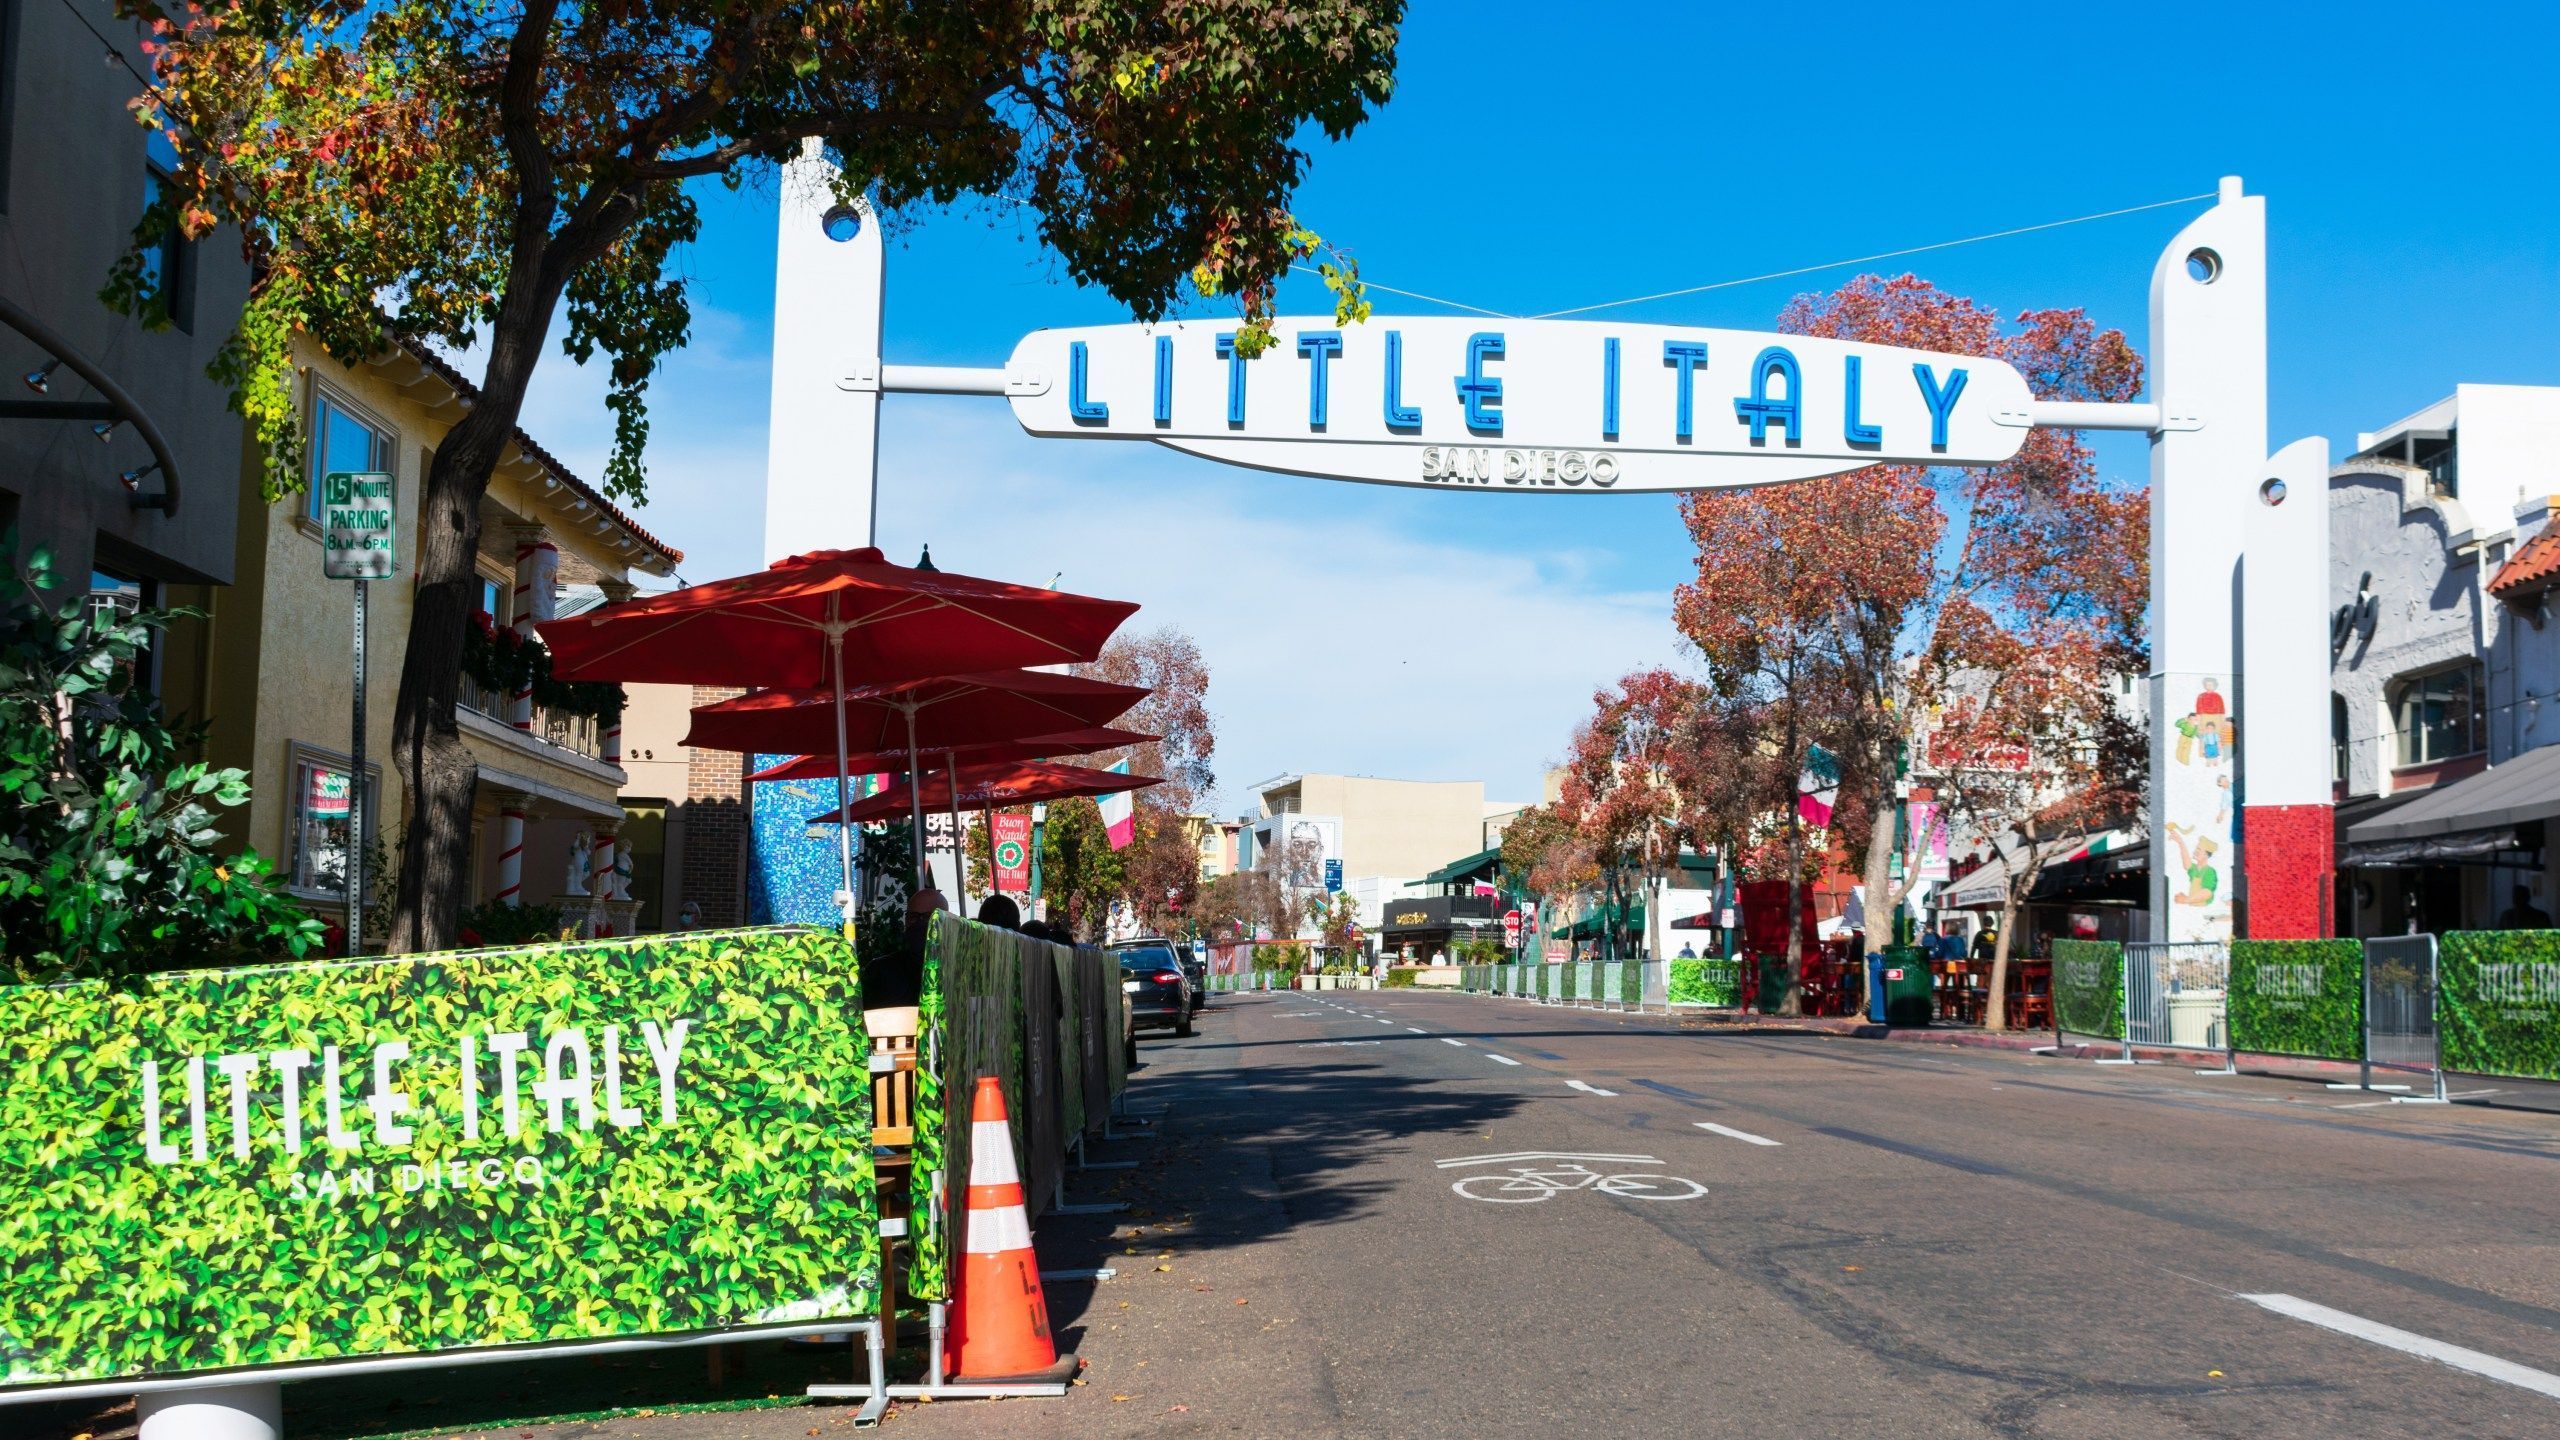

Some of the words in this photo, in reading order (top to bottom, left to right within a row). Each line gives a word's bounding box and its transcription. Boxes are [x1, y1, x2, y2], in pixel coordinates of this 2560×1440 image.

[1070, 331, 1504, 435] LITTLE
[1603, 338, 1968, 450] ITALY
[1423, 446, 1489, 483] SAN
[1504, 450, 1620, 487] DIEGO
[329, 478, 347, 500] 15
[353, 481, 389, 498] MINUTE
[330, 510, 388, 530] PARKING
[955, 787, 1021, 801] PANNA
[999, 817, 1024, 828] Buon
[995, 830, 1027, 841] Natale
[1505, 916, 1524, 925] STO
[1701, 969, 1732, 982] LITTLE
[2257, 965, 2289, 996] LITTLE
[2479, 963, 2526, 1001] LITTLE
[2531, 963, 2560, 1002] ITA
[143, 1041, 413, 1163] LITTLE
[461, 1019, 690, 1139] ITALY
[290, 1167, 375, 1199] SAN
[401, 1154, 544, 1193] DIEGO
